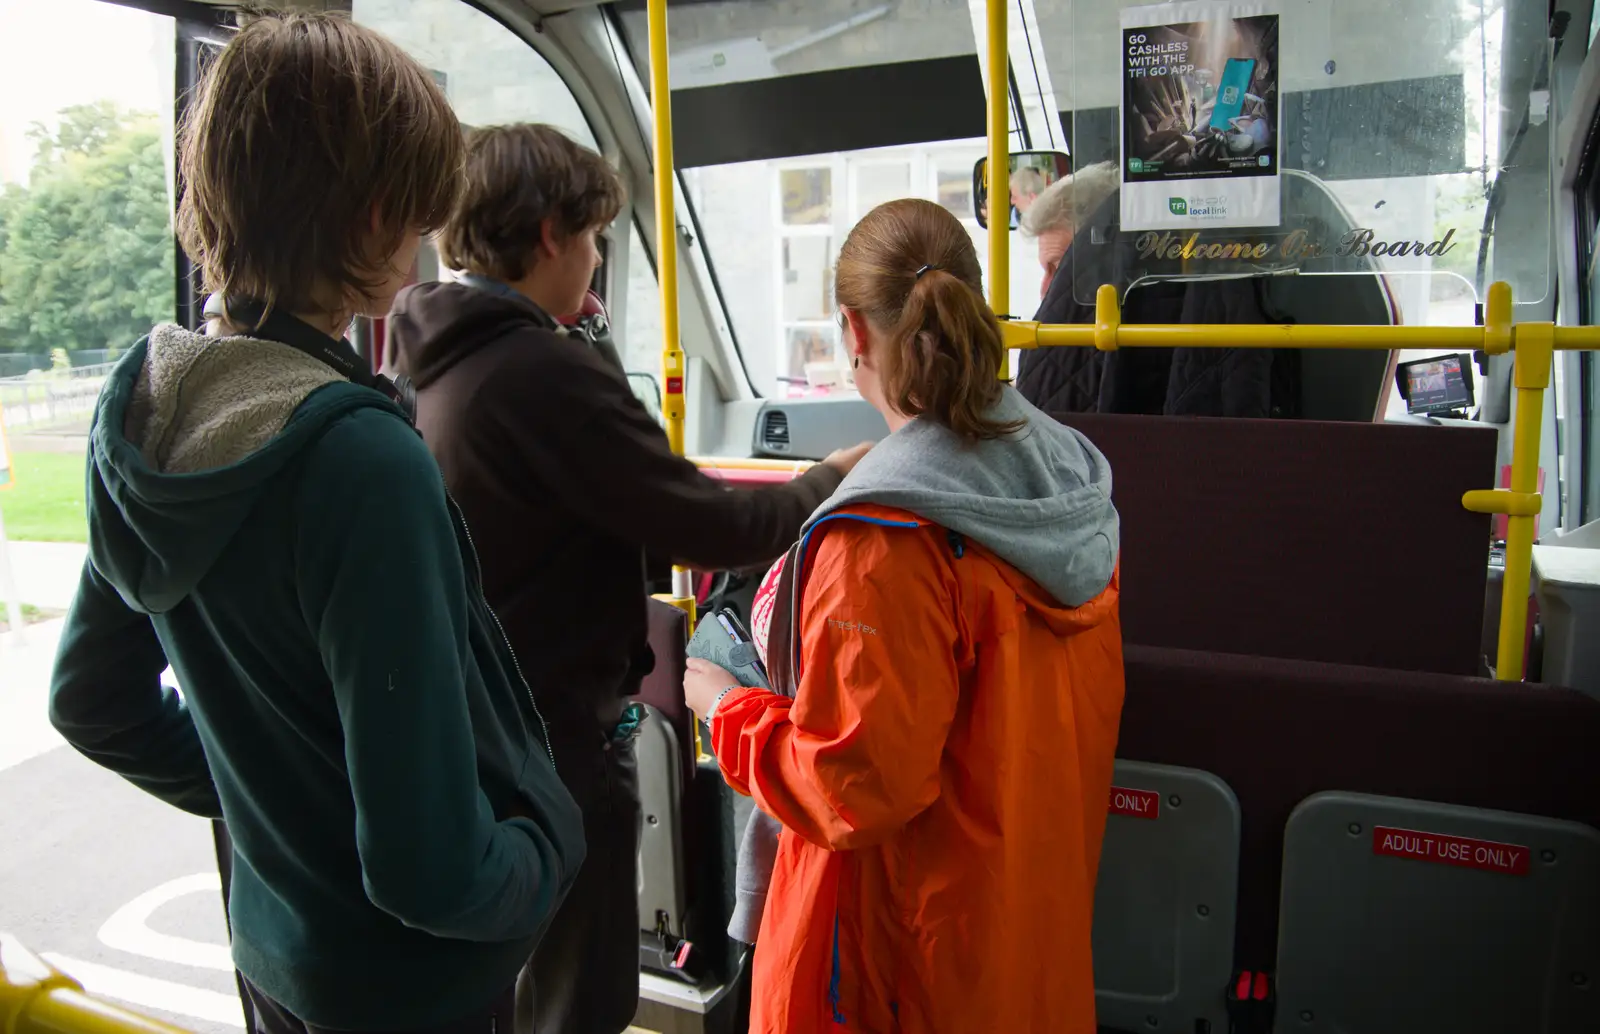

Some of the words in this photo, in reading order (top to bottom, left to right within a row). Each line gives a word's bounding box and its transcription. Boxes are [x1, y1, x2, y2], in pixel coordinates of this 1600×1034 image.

[1128, 34, 1147, 45] GO
[1128, 41, 1189, 56] CASHLESS
[1128, 55, 1160, 67] WITH
[1163, 53, 1187, 64] THE
[1128, 67, 1147, 78] TFI
[1149, 65, 1167, 76] GO
[1170, 64, 1195, 75] APP
[1189, 206, 1211, 215] local
[1211, 206, 1228, 215] link
[1135, 230, 1276, 260] Welcome
[1278, 229, 1325, 259] On
[1335, 228, 1458, 258] Board
[1114, 793, 1151, 813] ONLY
[1381, 833, 1434, 856] ADULT
[1437, 841, 1471, 862] USE
[1474, 847, 1520, 870] ONLY
